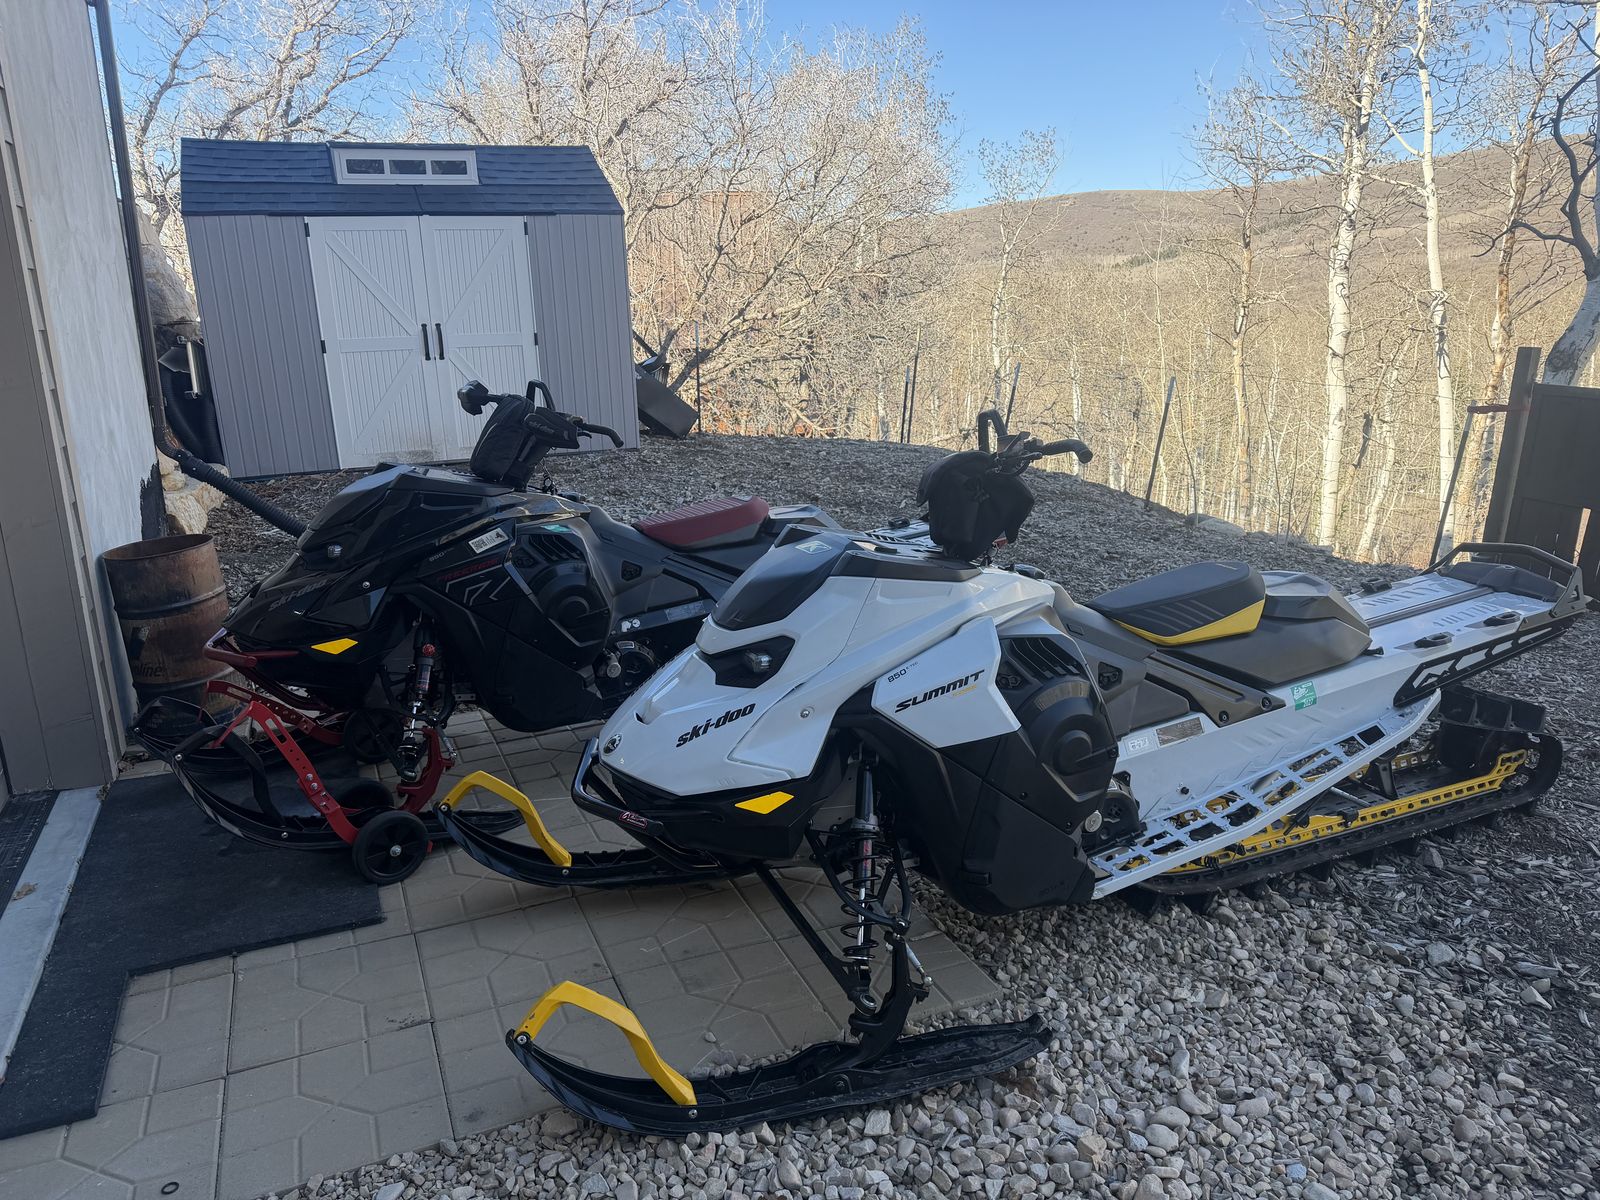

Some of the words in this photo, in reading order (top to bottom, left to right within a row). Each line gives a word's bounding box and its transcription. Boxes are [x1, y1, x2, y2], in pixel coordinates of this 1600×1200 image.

[887, 668, 907, 683] 850
[894, 669, 985, 713] SUMMIT
[676, 703, 756, 748] ski-doo
